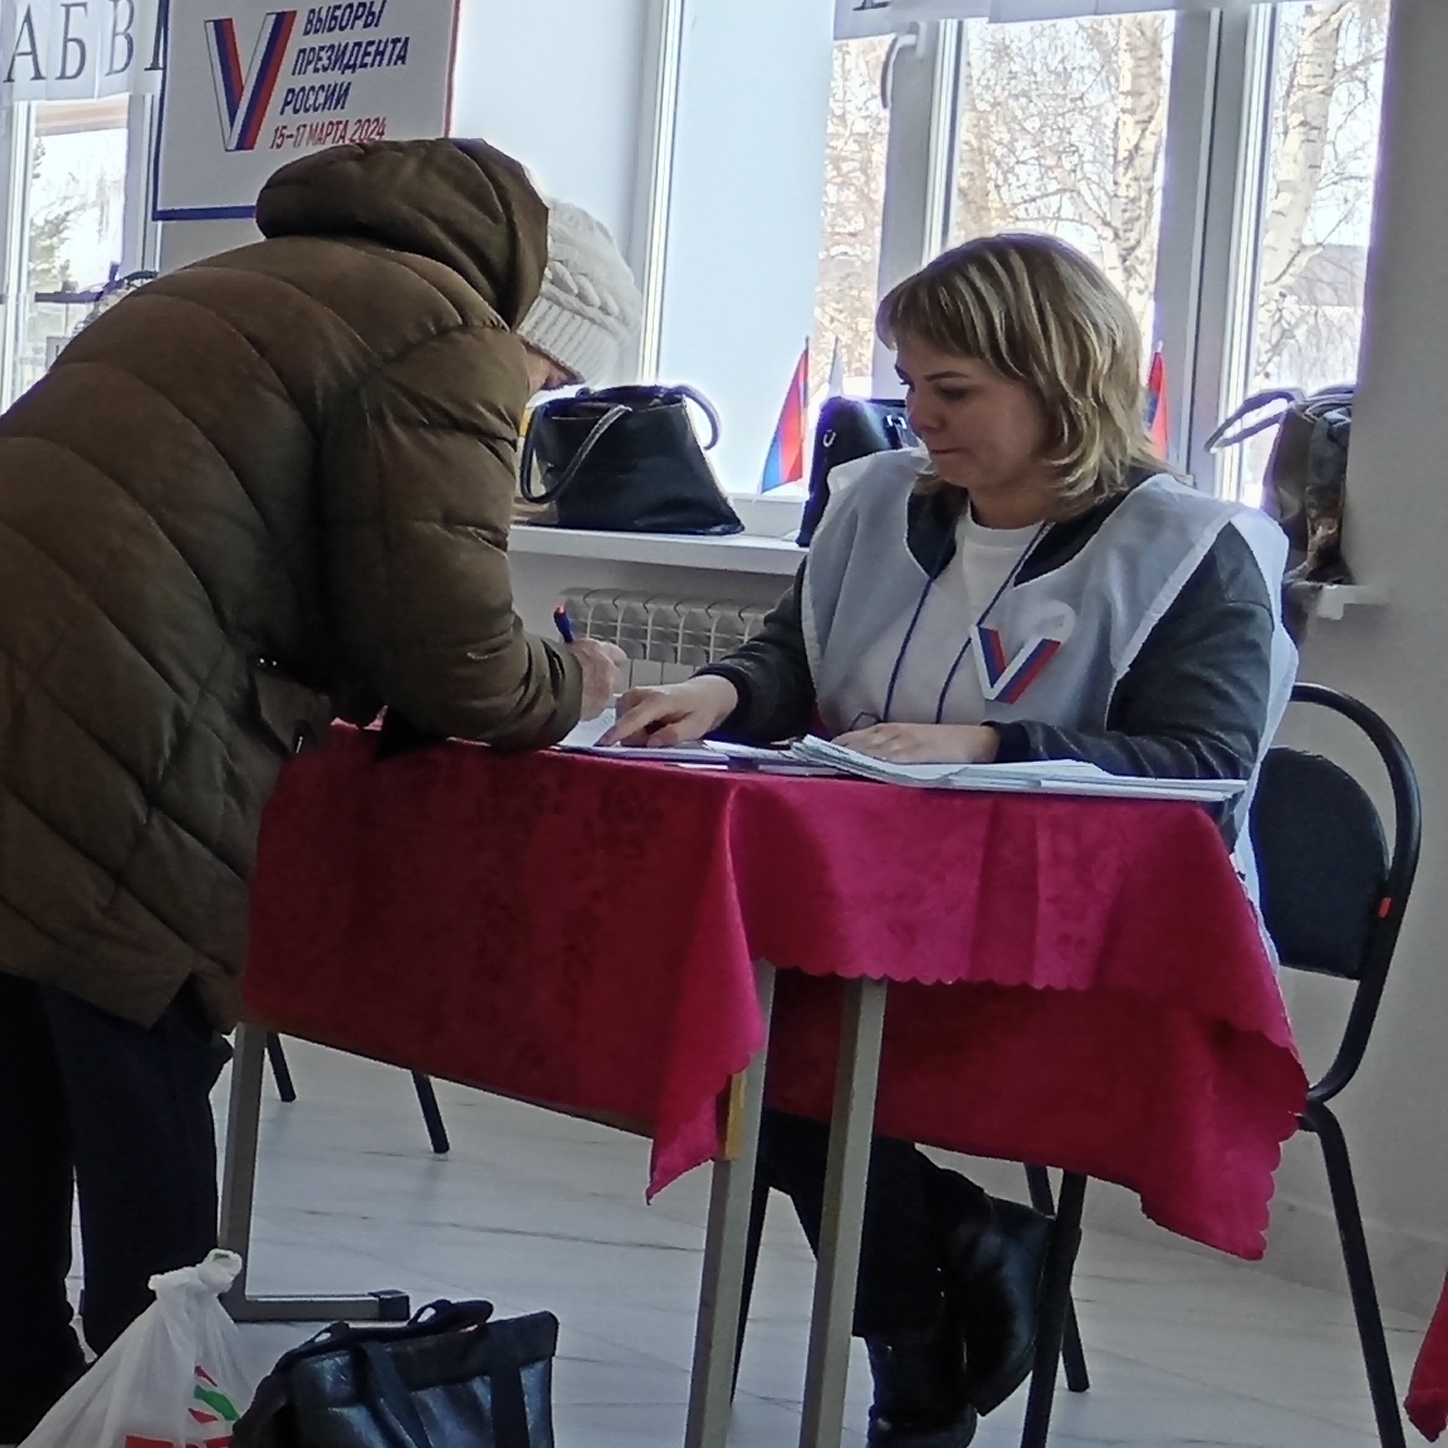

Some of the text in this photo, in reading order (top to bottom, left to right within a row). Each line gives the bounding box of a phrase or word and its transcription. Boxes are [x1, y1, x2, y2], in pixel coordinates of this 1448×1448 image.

[291, 37, 410, 77] ПРЕЗИДЕНТА
[279, 82, 352, 116] РОССИИ
[306, 119, 350, 148] МАРТА
[348, 116, 387, 144] 2024
